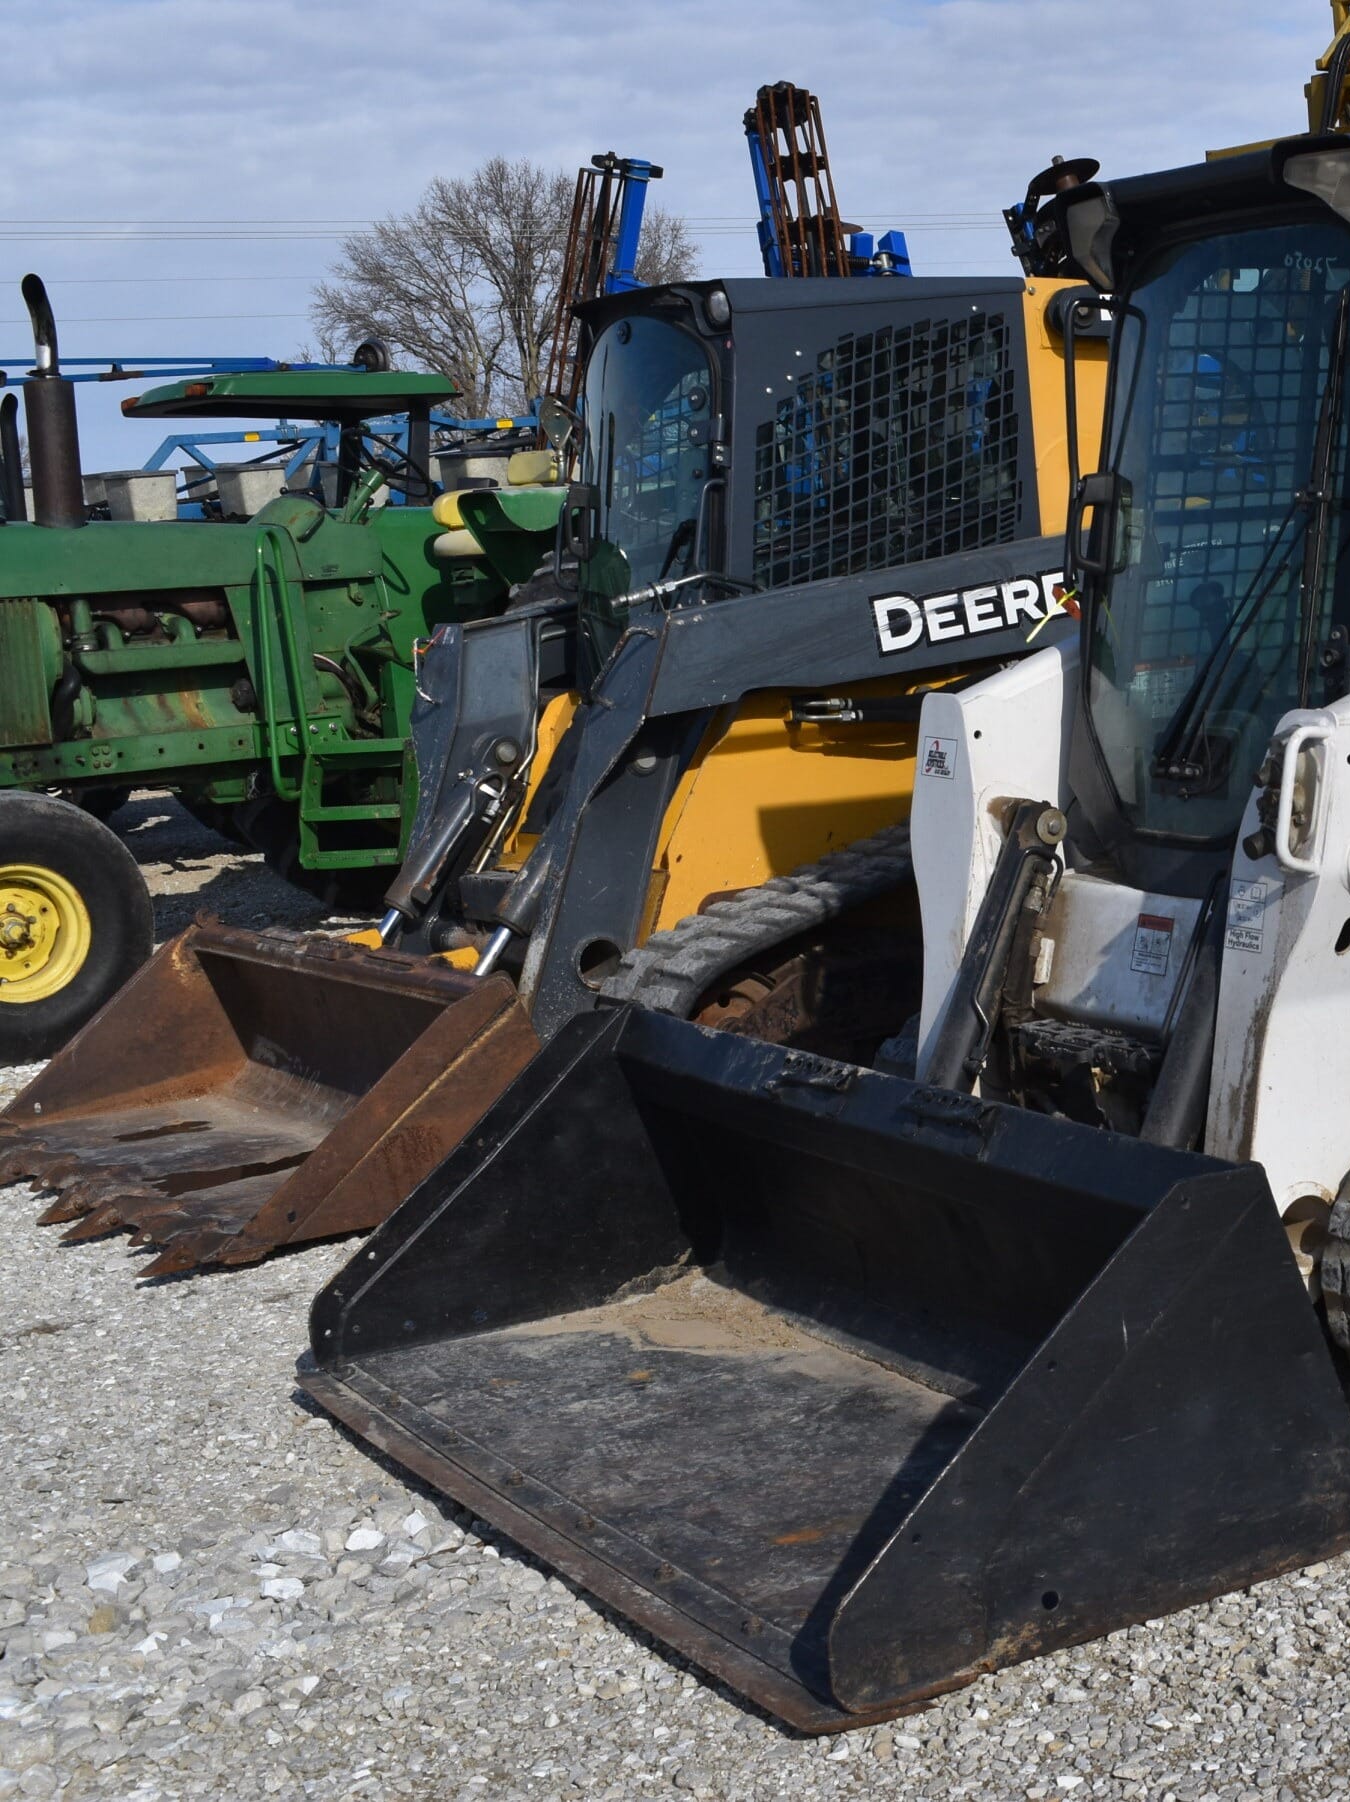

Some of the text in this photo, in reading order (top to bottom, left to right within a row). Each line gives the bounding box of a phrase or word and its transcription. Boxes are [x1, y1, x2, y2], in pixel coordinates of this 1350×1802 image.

[1229, 929, 1260, 942] High Flow
[1228, 939, 1260, 951] Hydraulics
